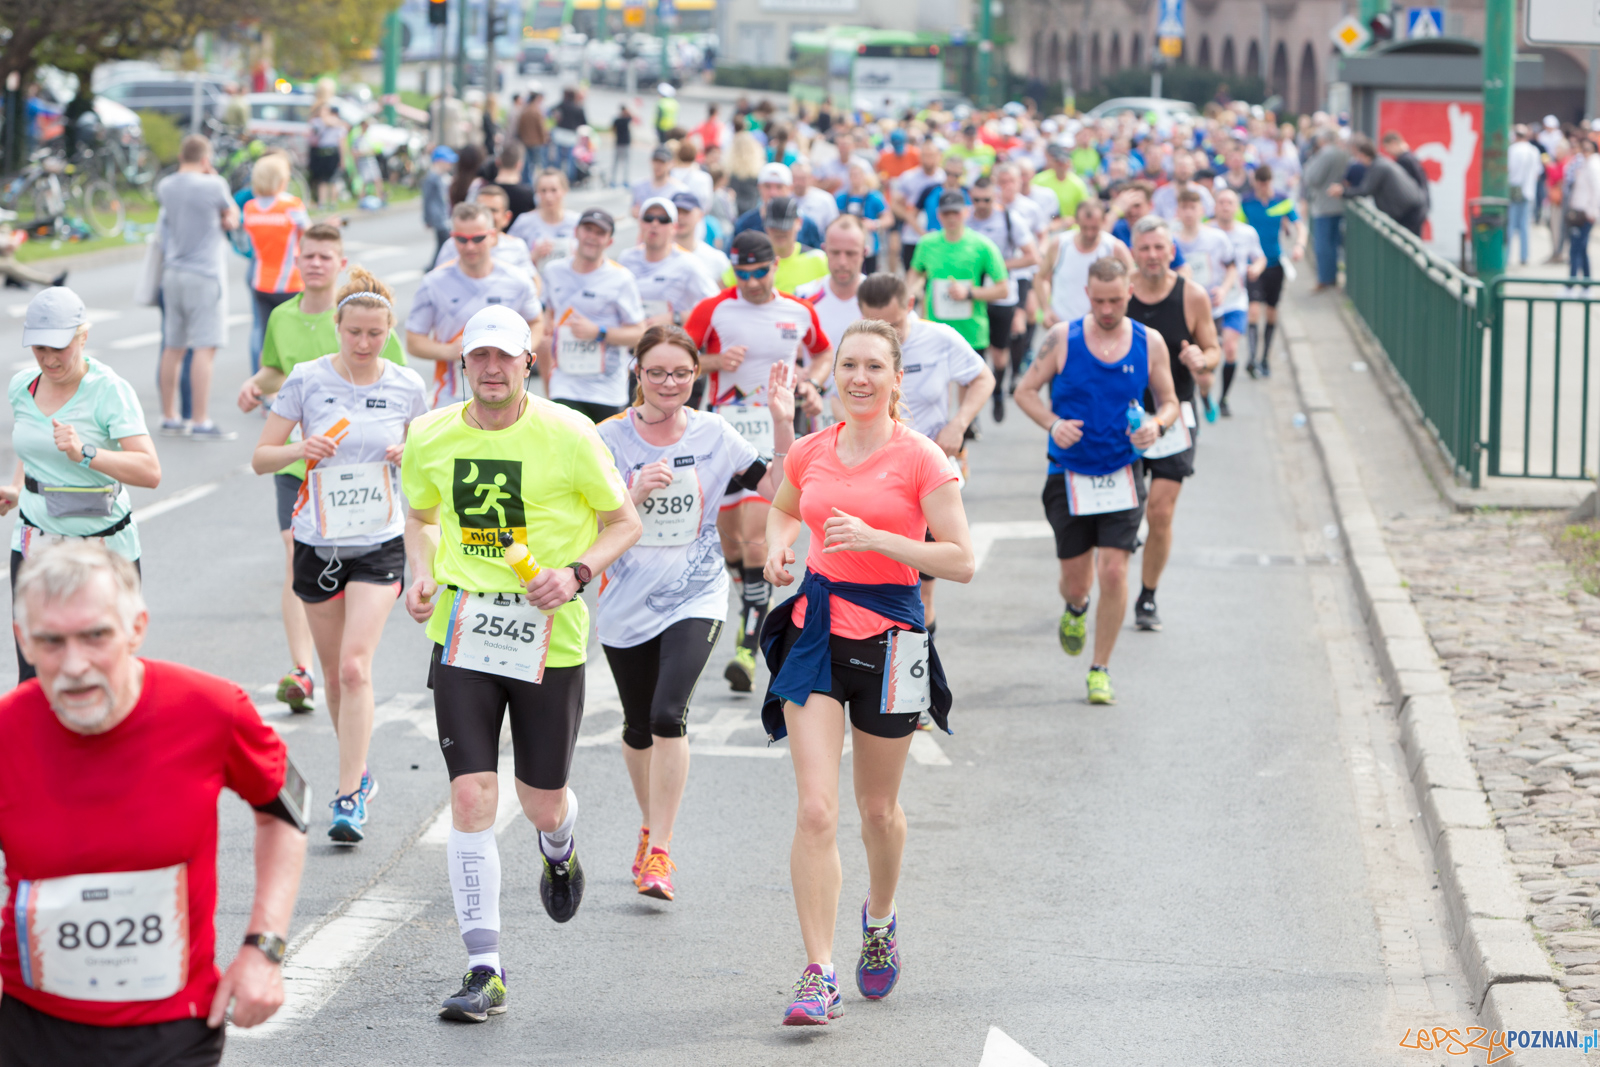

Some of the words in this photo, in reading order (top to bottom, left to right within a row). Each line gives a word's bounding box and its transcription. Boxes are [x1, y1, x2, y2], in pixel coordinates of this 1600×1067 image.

[1090, 476, 1116, 489] 126
[328, 487, 383, 507] 12274
[642, 494, 694, 515] 9389
[654, 518, 686, 526] Agnieszka
[460, 544, 506, 558] runne
[472, 612, 537, 644] 2545
[483, 640, 519, 653] Radosław
[57, 914, 164, 950] 8028
